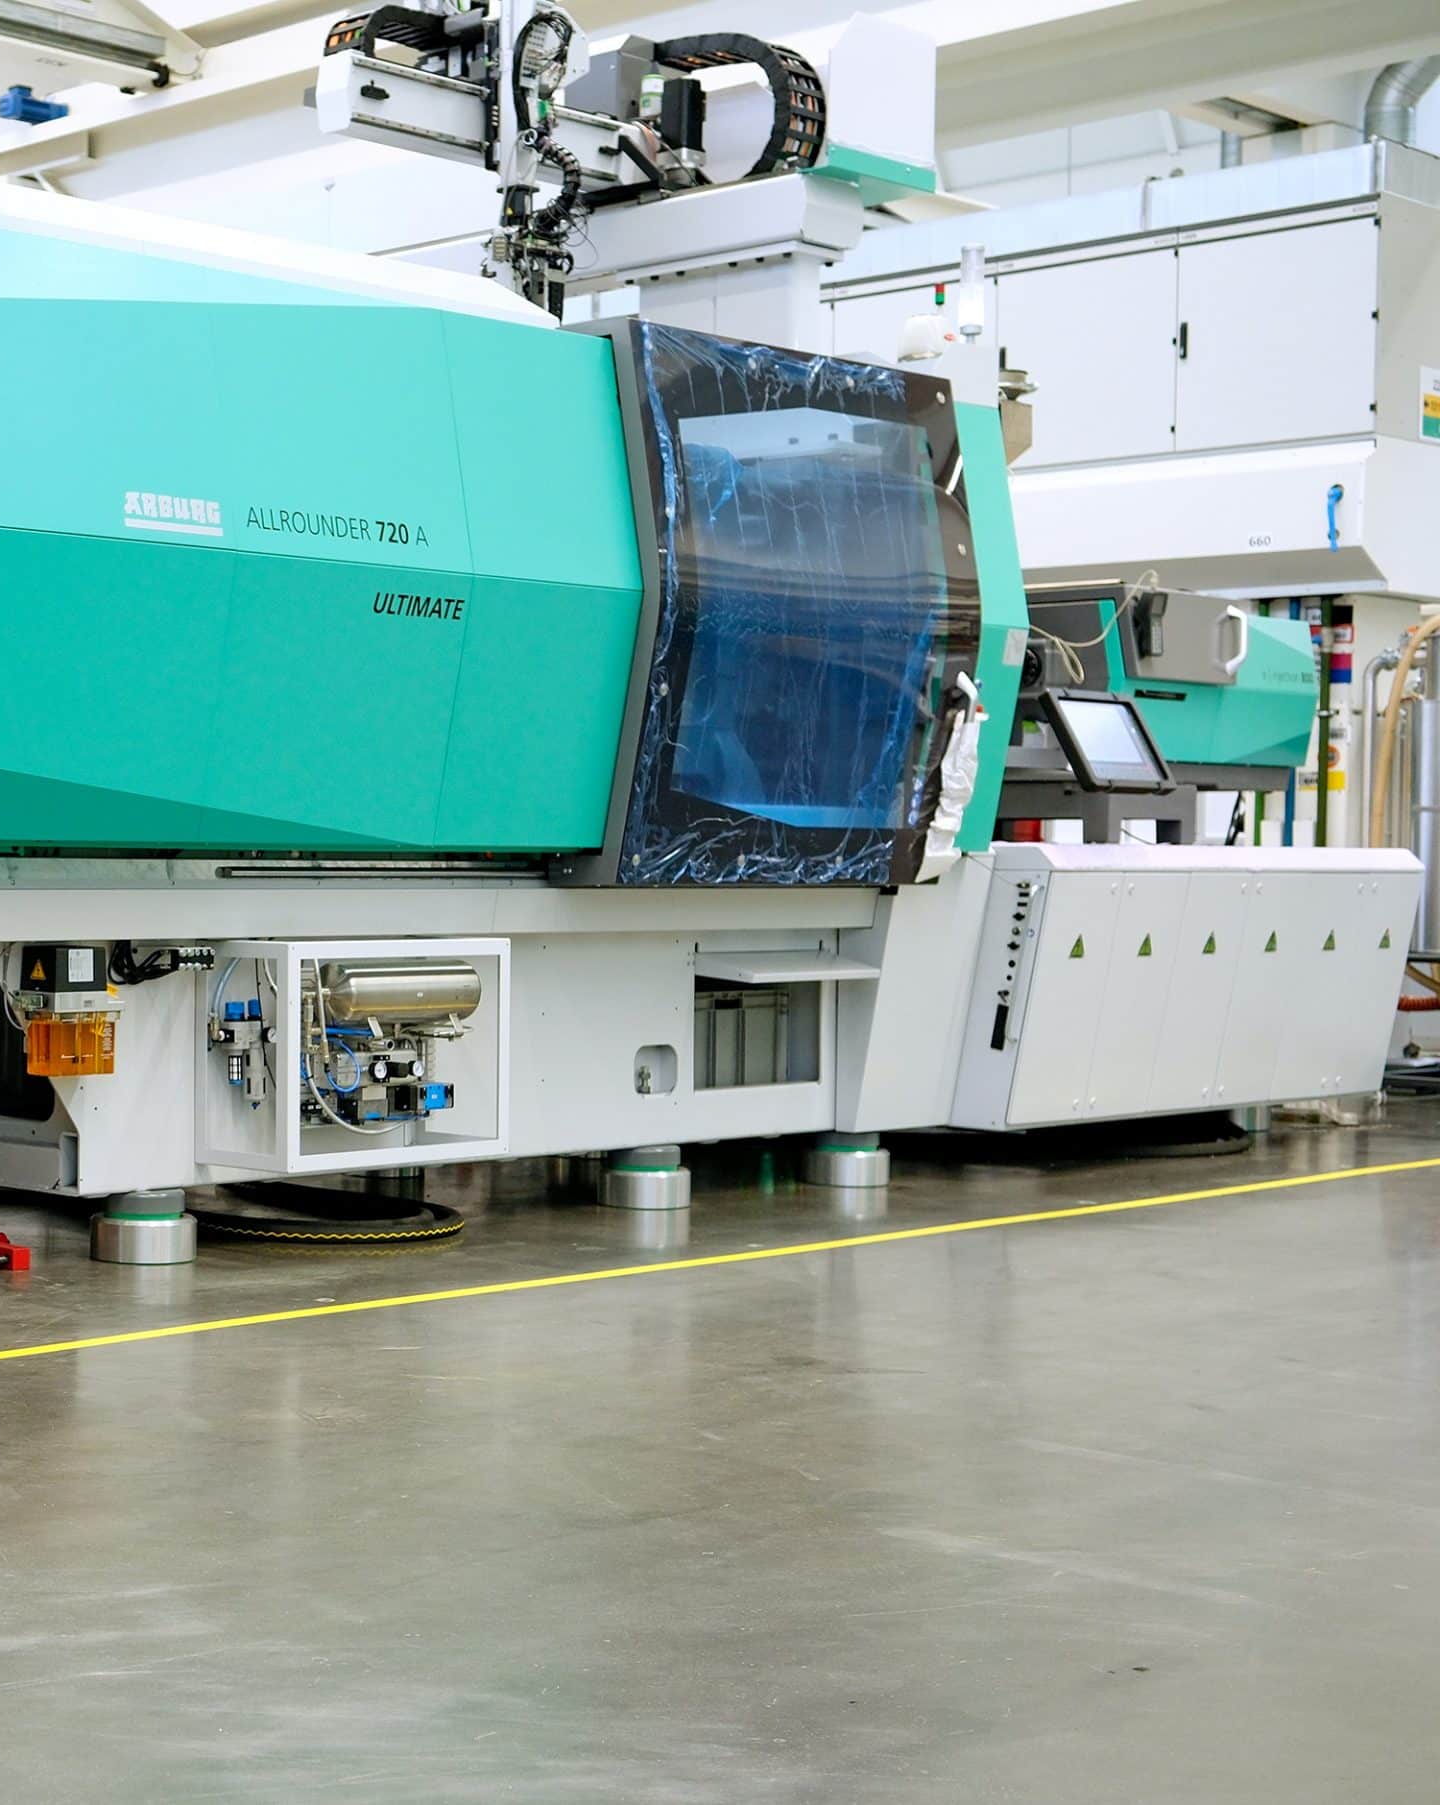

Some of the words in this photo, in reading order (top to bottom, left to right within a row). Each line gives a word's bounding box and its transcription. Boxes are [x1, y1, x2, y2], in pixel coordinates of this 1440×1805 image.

[124, 491, 221, 525] ARBURG
[246, 506, 372, 542] ALLROUNDER
[375, 520, 409, 545] 720
[415, 525, 430, 547] A
[1249, 535, 1272, 547] 660
[373, 591, 465, 620] ULTIMATE
